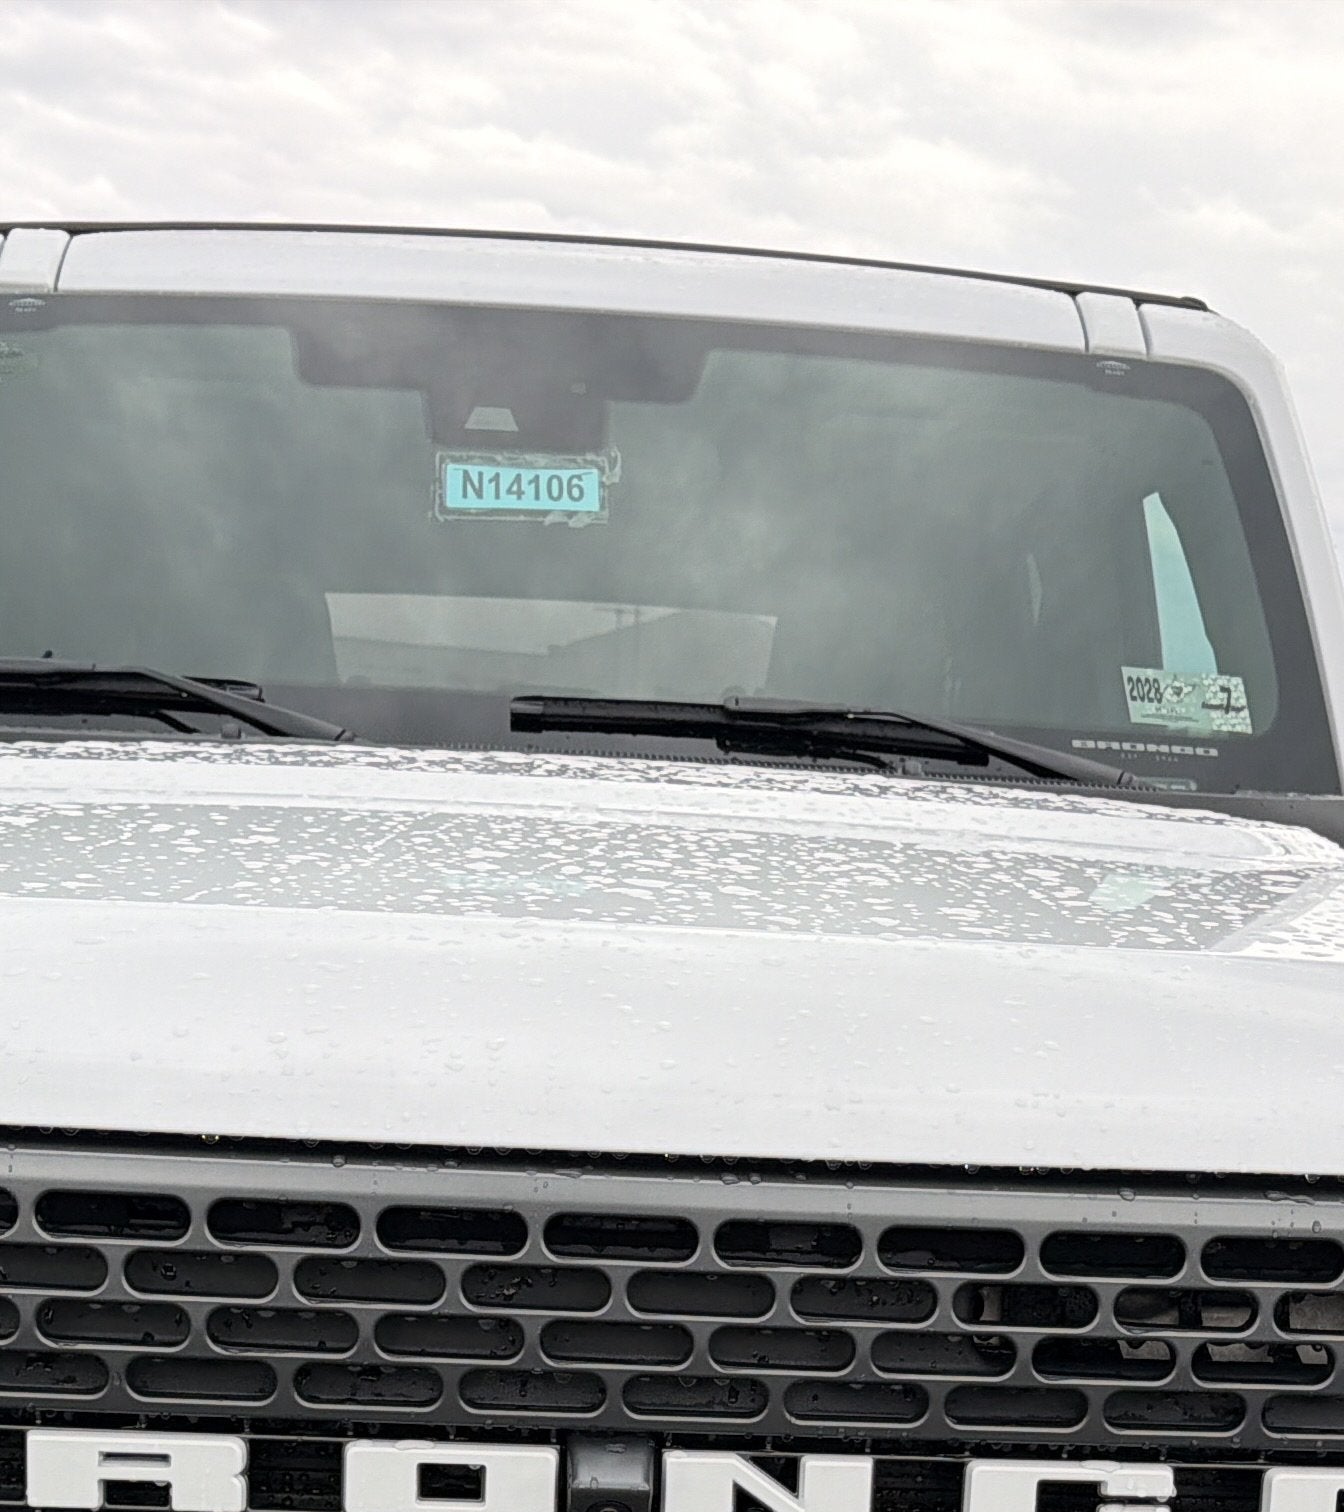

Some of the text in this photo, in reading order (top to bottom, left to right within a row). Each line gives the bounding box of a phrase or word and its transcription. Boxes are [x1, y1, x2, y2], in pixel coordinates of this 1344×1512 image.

[461, 469, 585, 502] N14106
[1127, 675, 1164, 704] 2028
[1071, 740, 1219, 757] BRONCO
